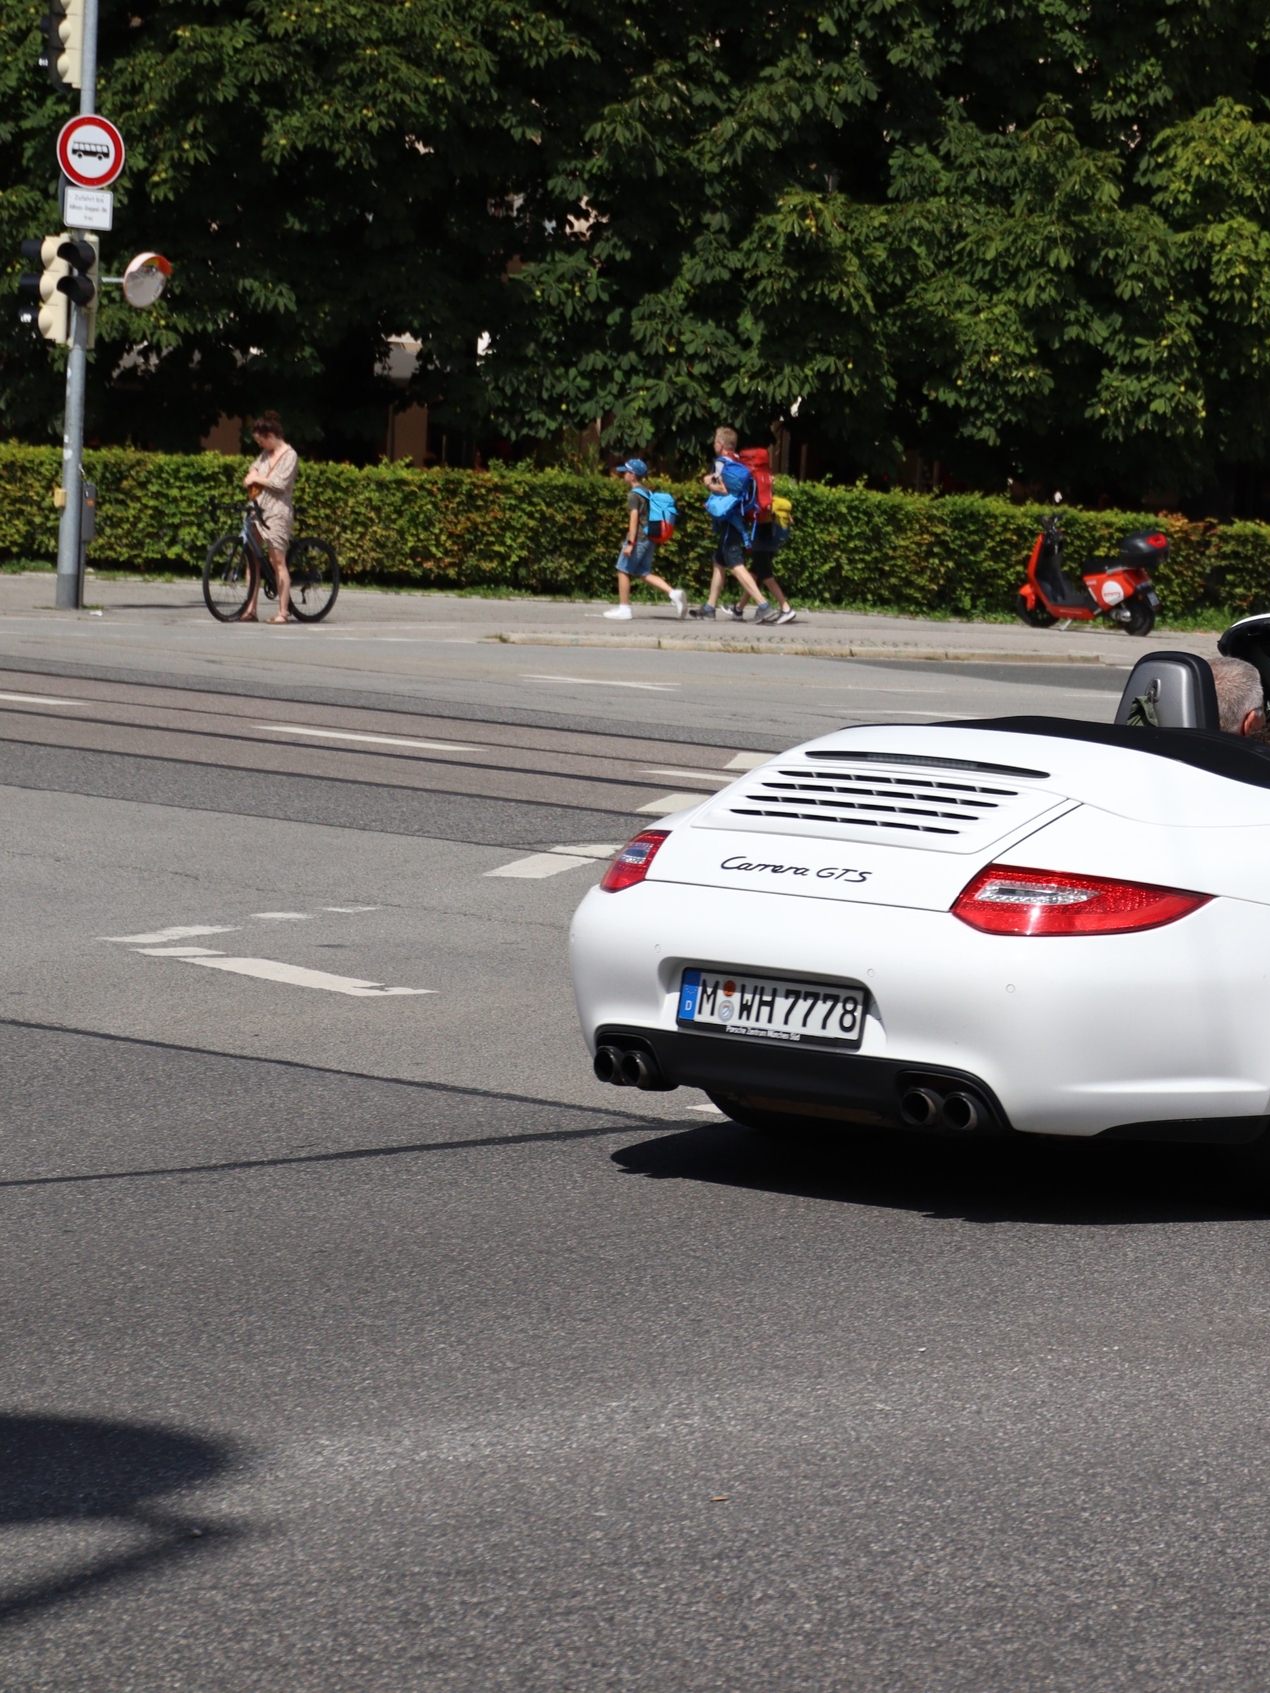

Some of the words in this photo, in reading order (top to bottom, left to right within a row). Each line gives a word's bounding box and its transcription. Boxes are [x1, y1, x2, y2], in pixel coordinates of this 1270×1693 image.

[721, 856, 810, 877] Carrera
[816, 867, 873, 883] GTS
[685, 1000, 692, 1010] D
[698, 978, 720, 1016] M
[738, 983, 778, 1024] WH
[783, 988, 859, 1033] 7778
